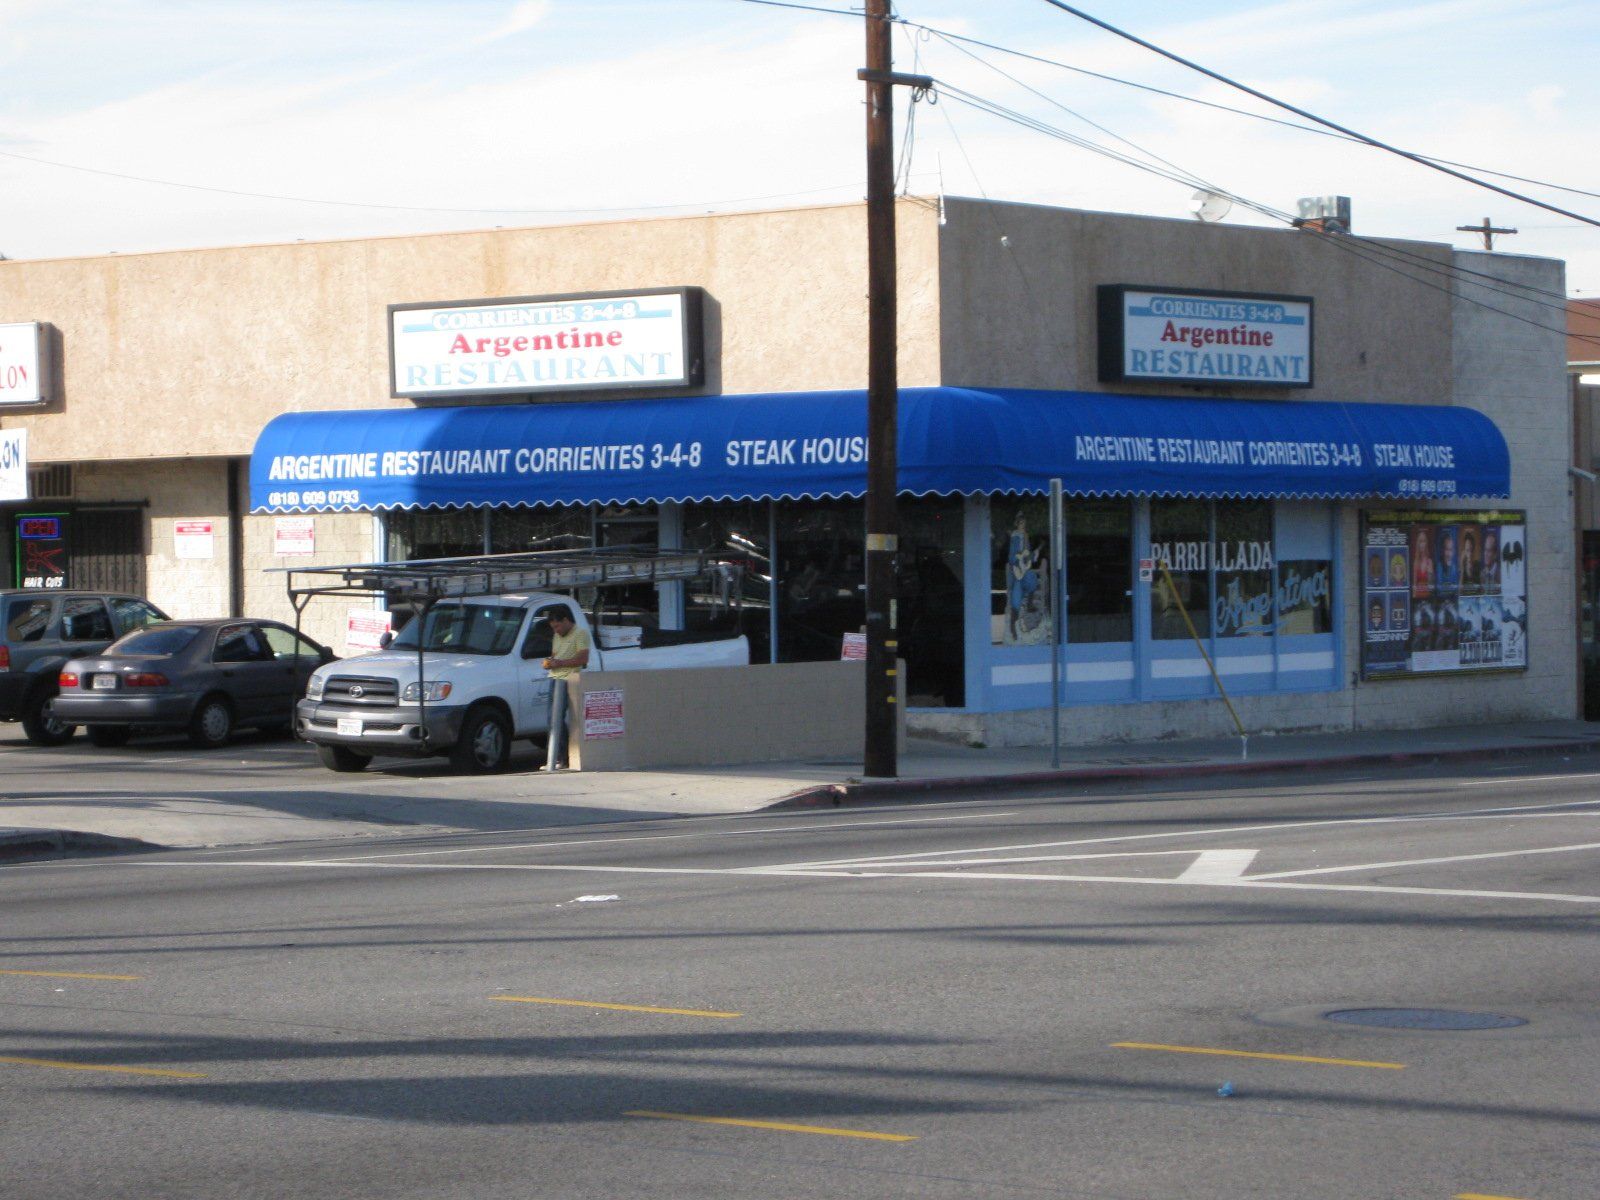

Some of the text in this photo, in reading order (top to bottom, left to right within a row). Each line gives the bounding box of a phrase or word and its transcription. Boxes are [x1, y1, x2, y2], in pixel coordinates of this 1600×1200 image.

[433, 302, 637, 330] CORRIENTES 3-4-8
[1151, 299, 1283, 322] CORRIENTES 3-4-8
[449, 327, 623, 357] Argentine
[1161, 320, 1274, 348] Argentine
[406, 352, 672, 387] RESTAURANT
[1130, 349, 1304, 379] RESTAURANT
[269, 436, 870, 480] ARGENTINE RESTAURANT CORRIENTES 3-4-8 STEAK HOUS
[1075, 435, 1455, 468] ARGENTINE RESTAURANT CORRIENTES 3-4-8 STEAK HOUSE
[302, 491, 326, 505] 609
[328, 489, 359, 504] 0793
[1151, 541, 1276, 571] PARRILLADA
[24, 576, 43, 588] HAIR
